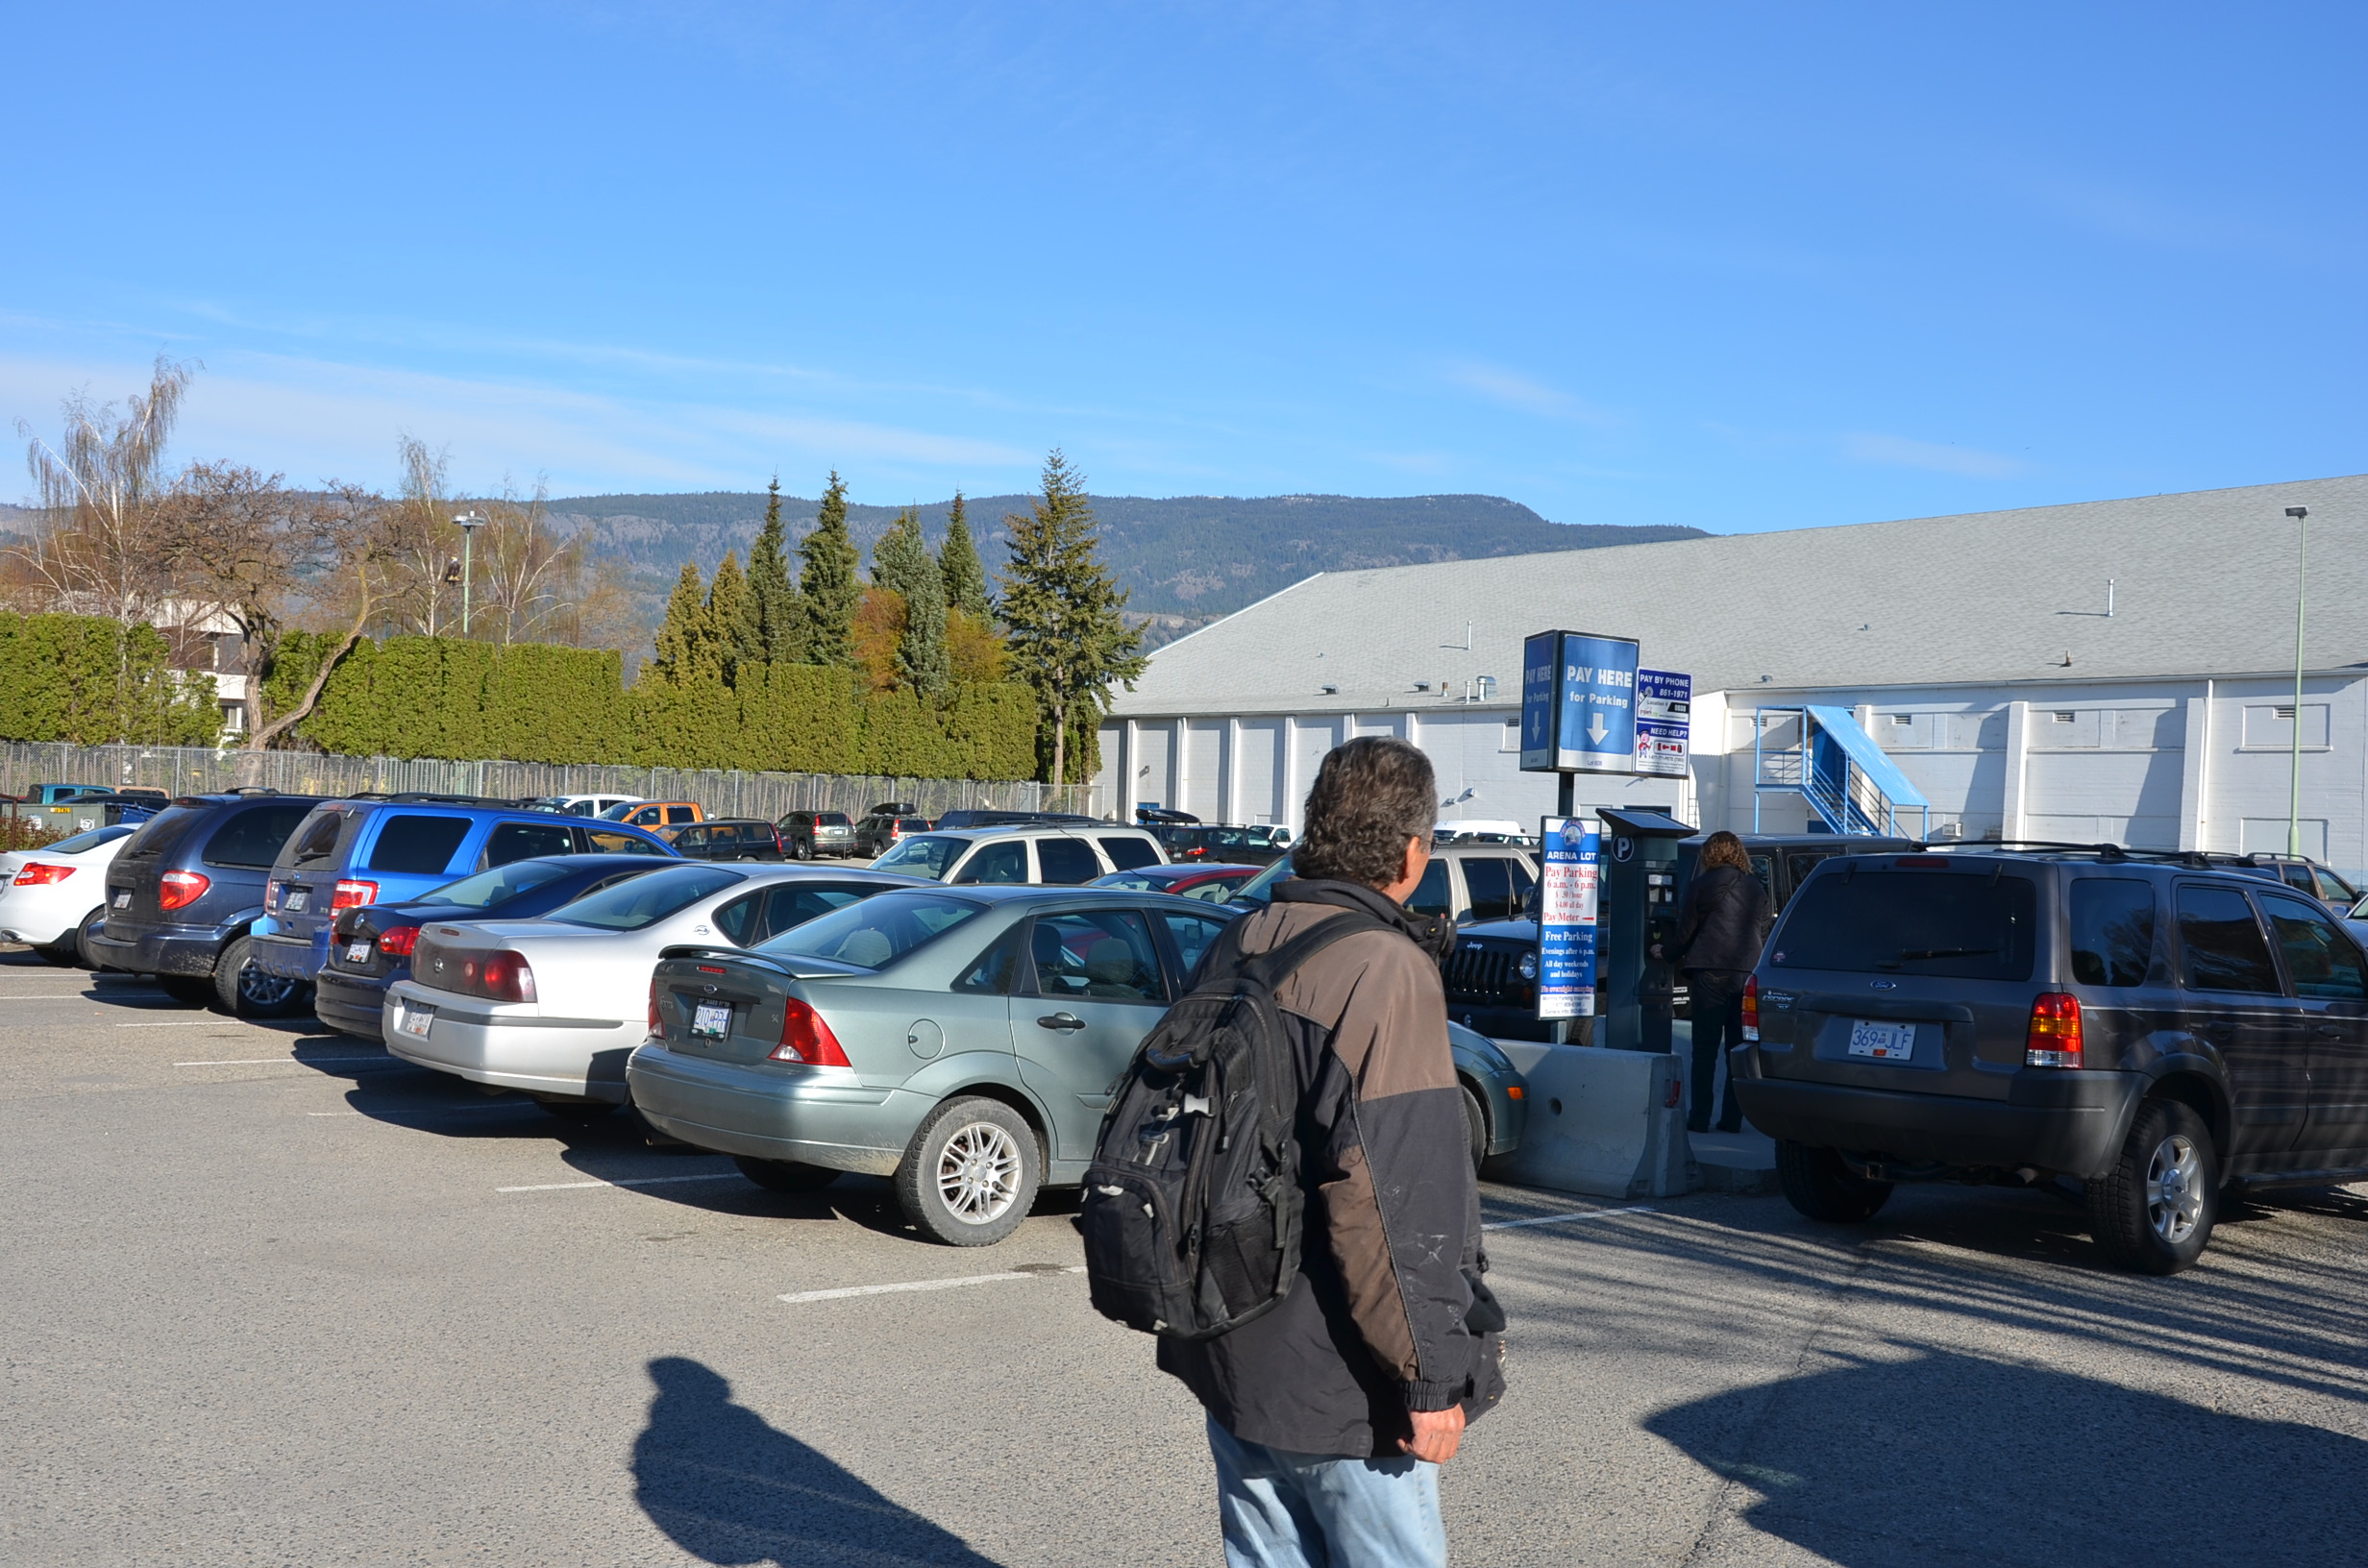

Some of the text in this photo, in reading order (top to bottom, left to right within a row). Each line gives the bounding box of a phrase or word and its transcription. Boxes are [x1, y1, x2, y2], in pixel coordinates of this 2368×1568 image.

[1537, 665, 1552, 683] HERE
[1566, 665, 1633, 688] PAY HERE
[1654, 675, 1664, 684] BY
[1665, 677, 1690, 687] PHONE
[1660, 689, 1688, 698] 861-1971
[1569, 691, 1628, 709] for Parking
[1650, 727, 1688, 738] NEED HELP?
[1618, 838, 1630, 858] P
[1546, 851, 1596, 861] ARENA LOT
[1545, 866, 1598, 881] Pay Parking
[1546, 879, 1551, 889] 6
[1574, 880, 1579, 889] 6
[1580, 882, 1596, 891] p.m.
[1543, 912, 1580, 922] Pay Meter
[1544, 931, 1593, 943] Free Parking
[1542, 947, 1565, 956] Evenings
[1553, 960, 1564, 968] day
[1561, 970, 1583, 979] holidays
[1852, 1029, 1878, 1047] 369
